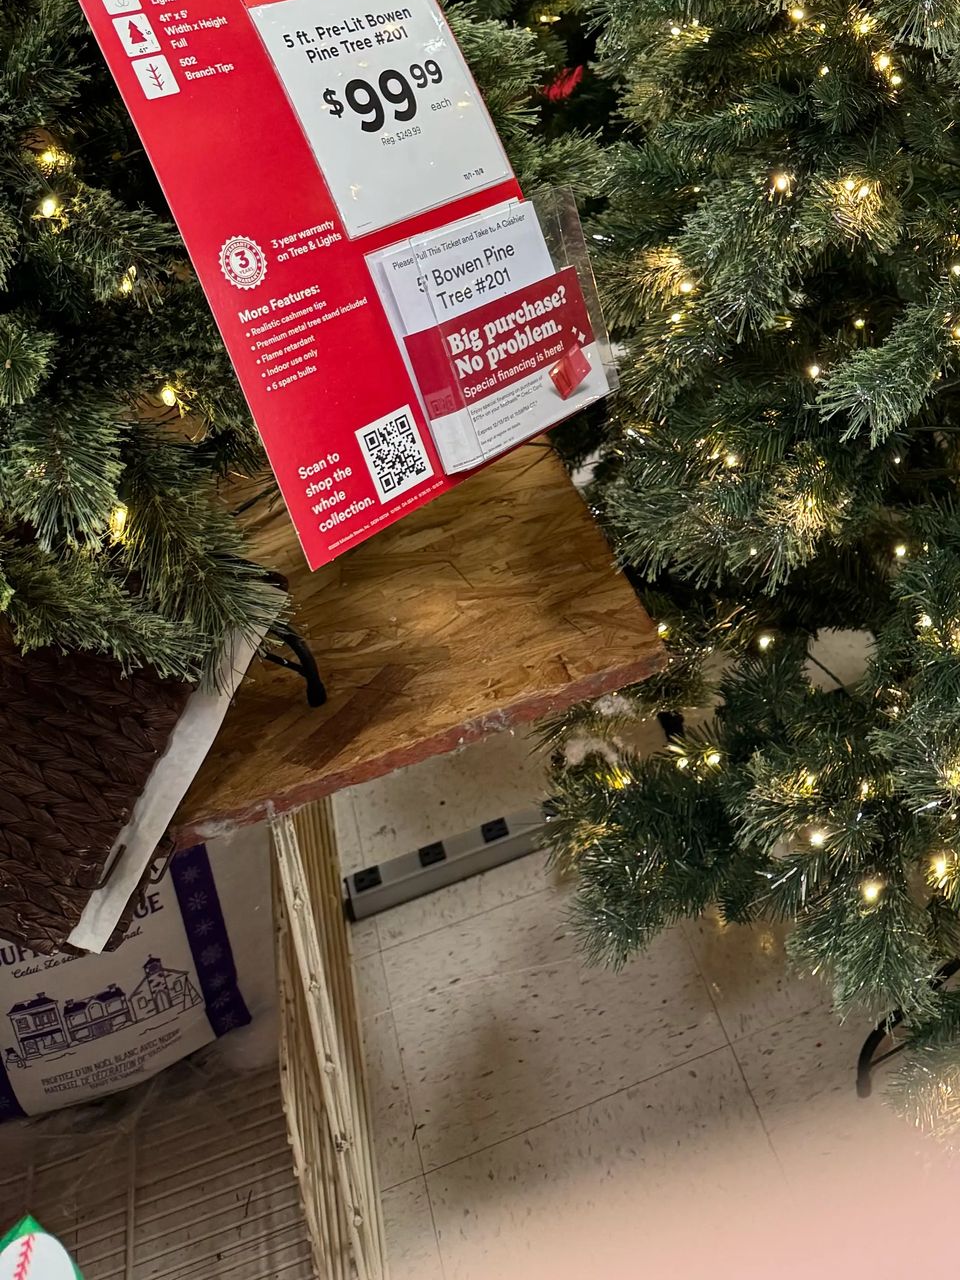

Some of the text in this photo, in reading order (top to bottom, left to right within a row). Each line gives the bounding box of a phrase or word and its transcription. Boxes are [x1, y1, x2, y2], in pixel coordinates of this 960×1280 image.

[283, 8, 412, 48] 5 ft. Pre-Lit Bowen
[305, 26, 408, 64] Pine Tree #201
[179, 56, 198, 67] 502
[184, 63, 234, 80] Branch Tips
[431, 98, 452, 111] each
[432, 257, 484, 286] Bowen
[483, 245, 515, 265] Pine
[238, 285, 320, 323] More Features:
[436, 267, 511, 309] Tree #201
[250, 301, 327, 336] Realistic cashmere tips
[447, 286, 567, 355] Big purchase?
[455, 320, 562, 379] No problem.
[272, 365, 317, 390] 6 spare bulbs
[298, 453, 340, 480] Scan to
[306, 467, 352, 497] shop the
[312, 491, 346, 514] whole
[319, 497, 375, 532] collection.
